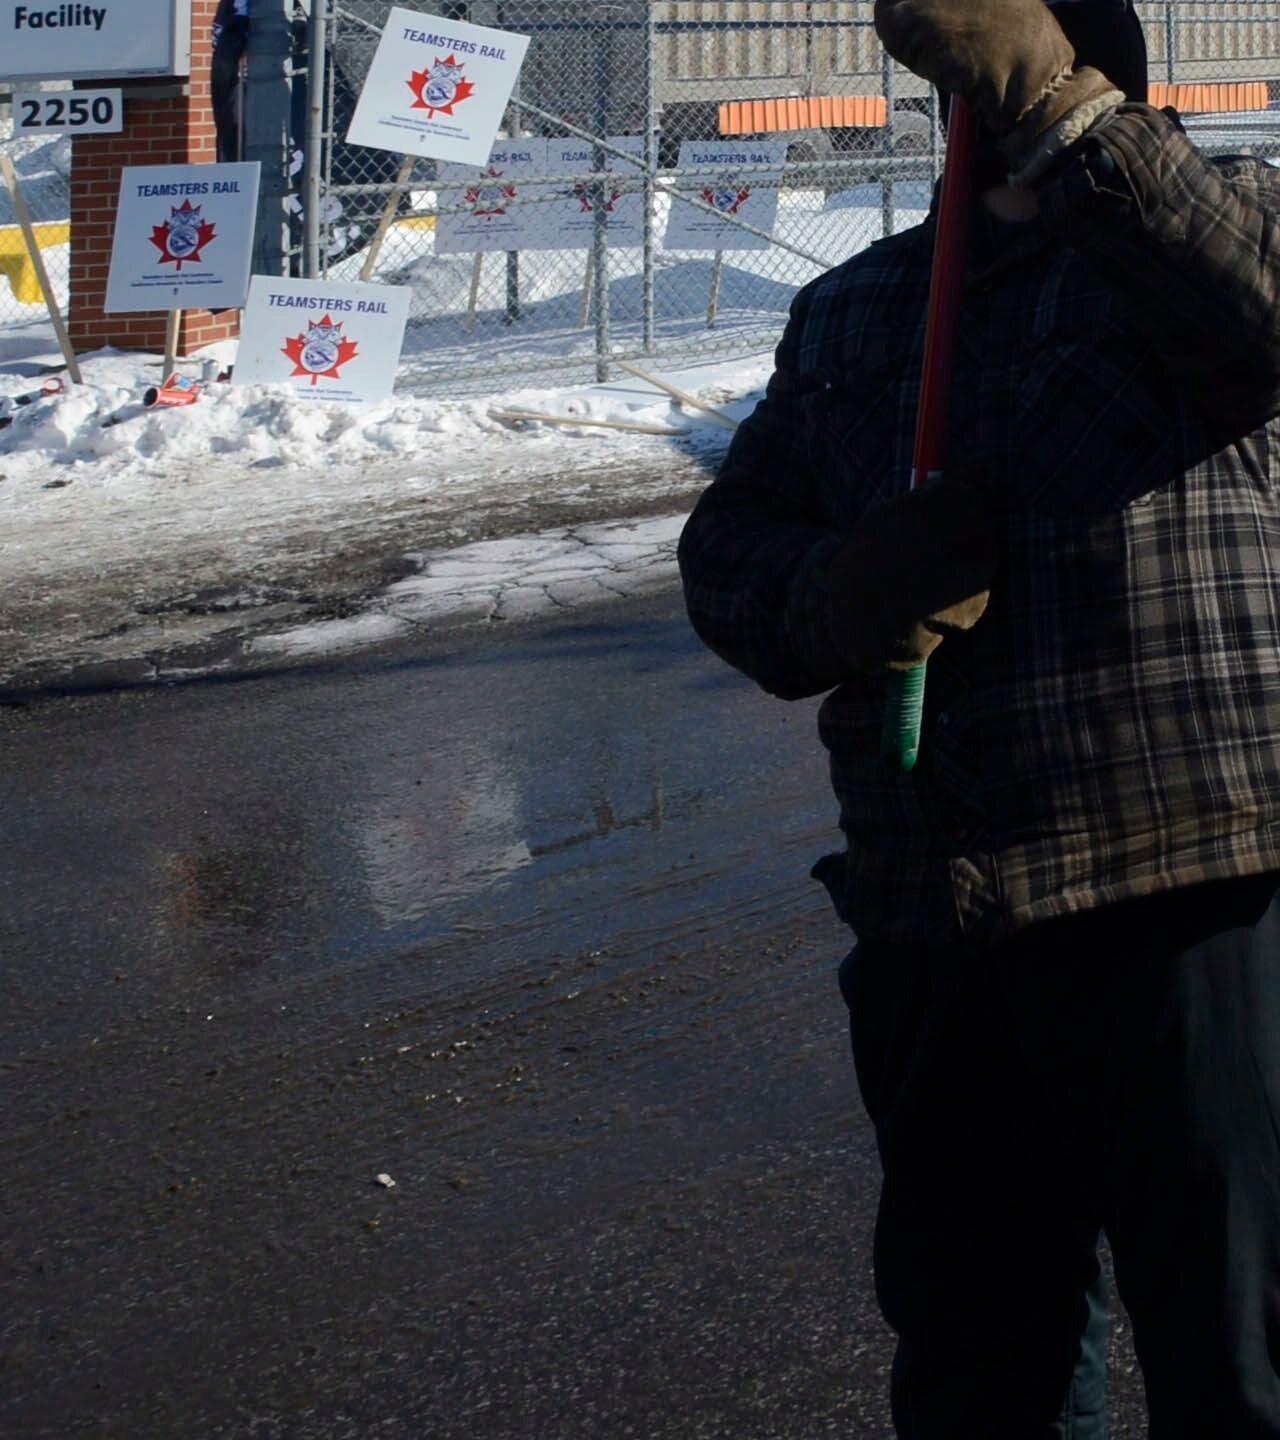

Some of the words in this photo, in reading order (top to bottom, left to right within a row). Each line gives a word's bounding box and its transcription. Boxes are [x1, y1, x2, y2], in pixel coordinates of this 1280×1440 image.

[14, 3, 107, 31] Facility
[402, 27, 478, 54] TEAMSTERS
[479, 44, 507, 61] RAIL
[21, 96, 114, 128] 2250
[136, 181, 209, 198] TEAMSTERS
[212, 180, 240, 194] RAIL
[268, 294, 353, 312] TEAMSTERS
[357, 300, 389, 314] RAIL
